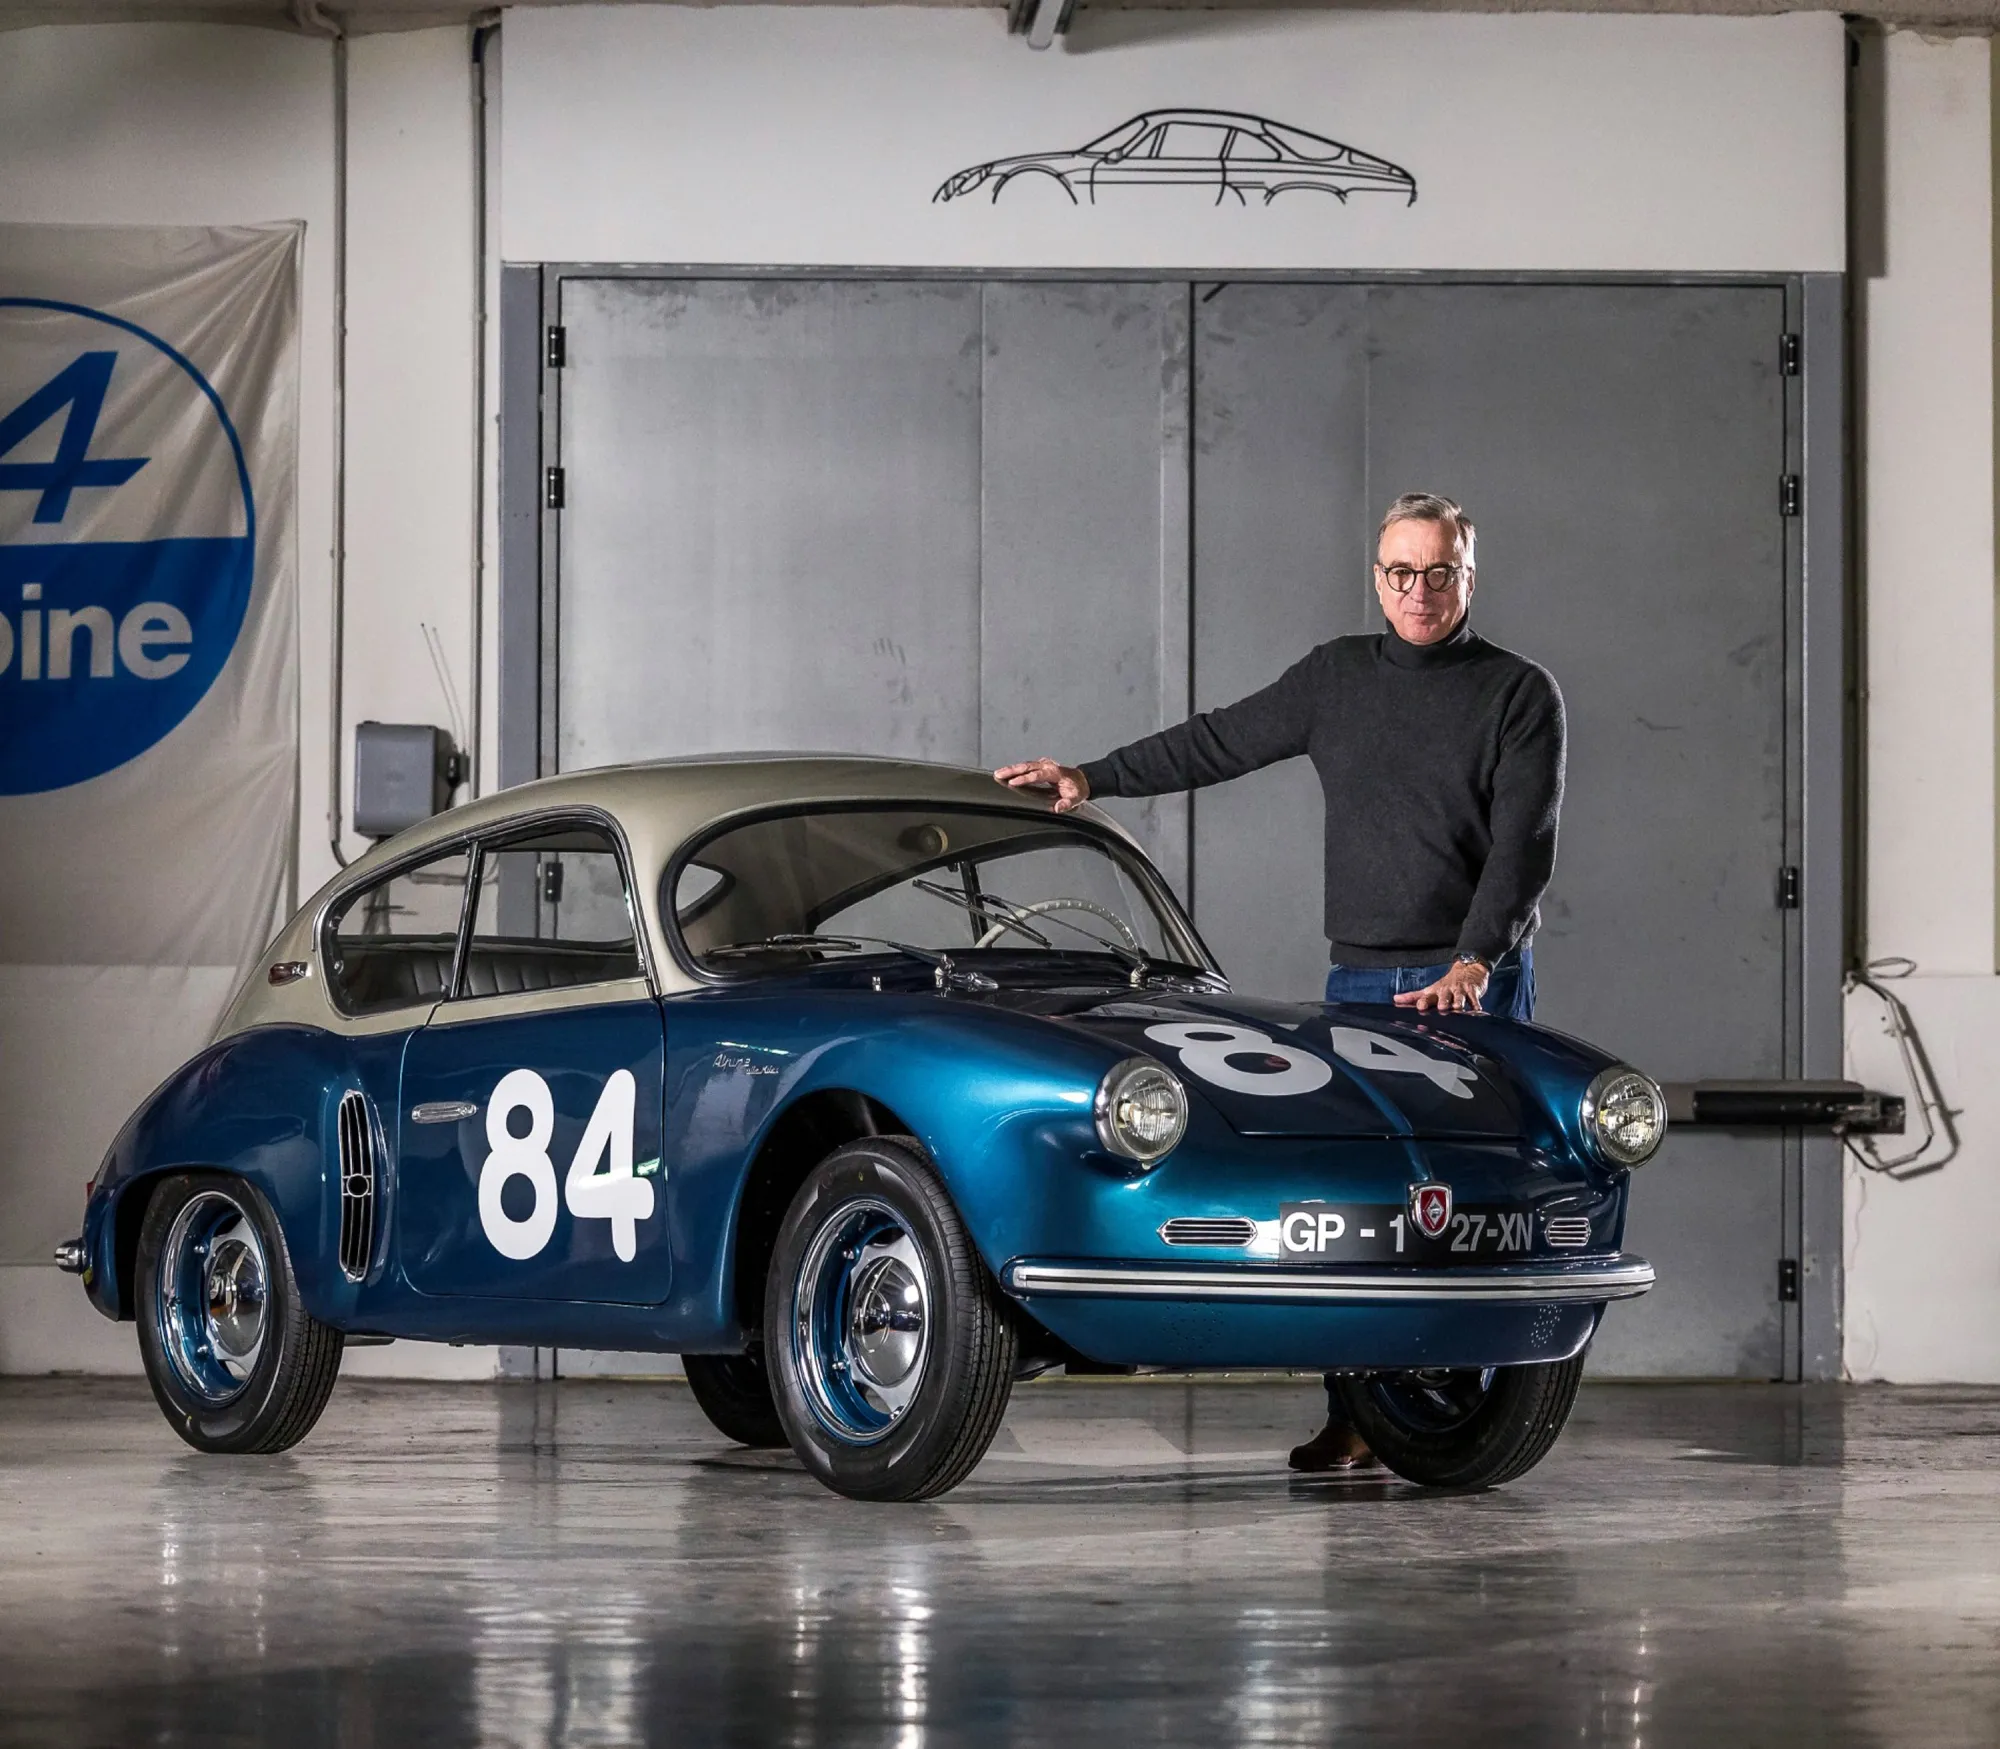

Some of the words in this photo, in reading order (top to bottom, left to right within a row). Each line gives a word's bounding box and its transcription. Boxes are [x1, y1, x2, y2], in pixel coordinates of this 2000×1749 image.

[1143, 1022, 1479, 1099] 84
[478, 1068, 655, 1262] 84
[1282, 1211, 1346, 1252] GP
